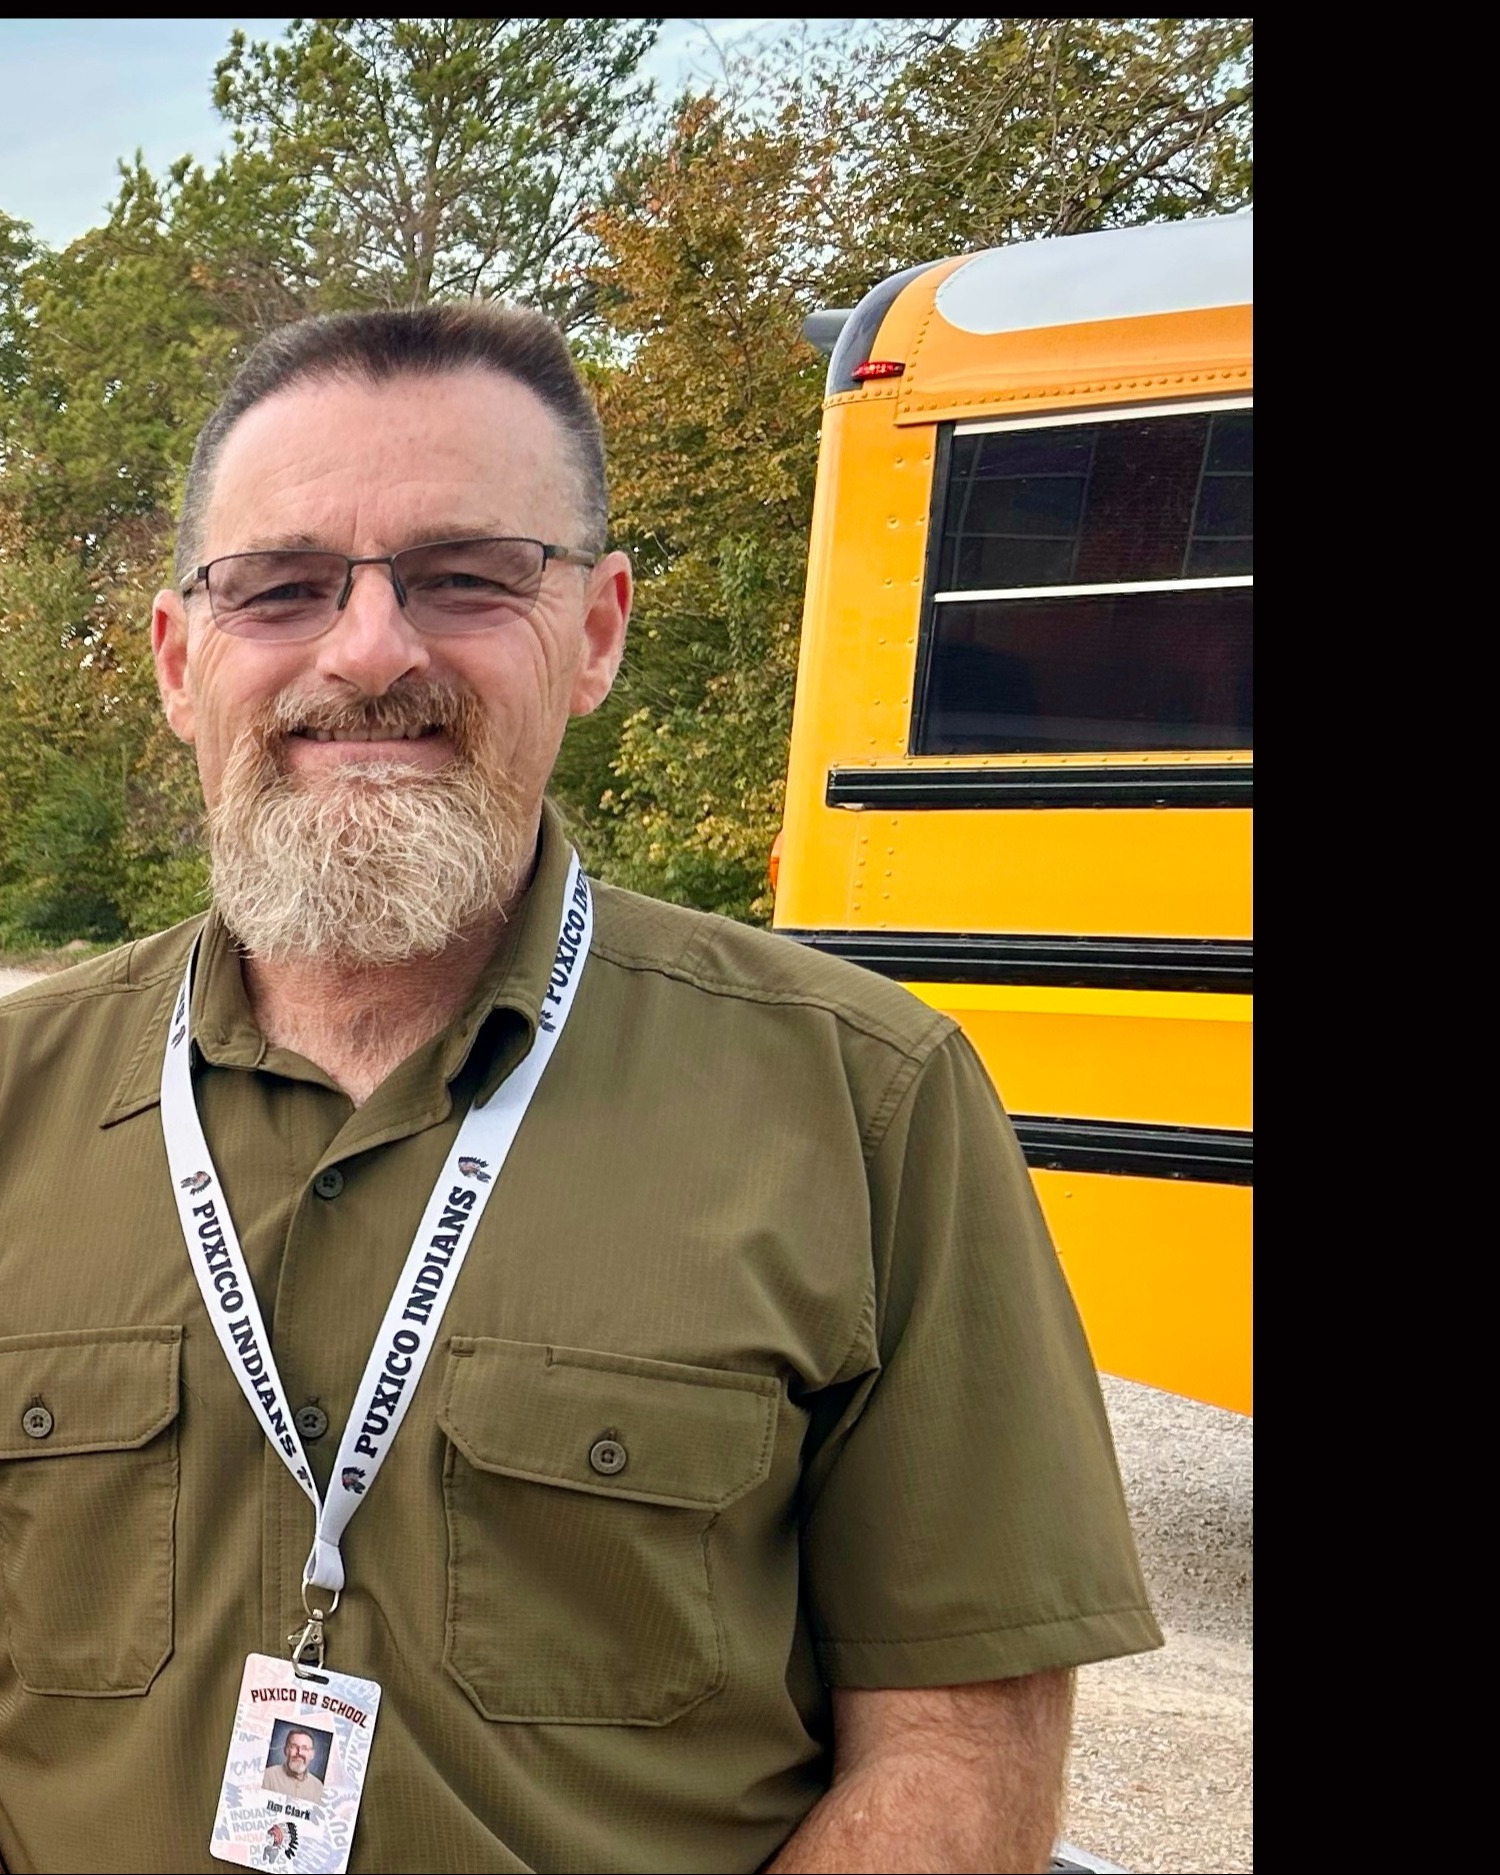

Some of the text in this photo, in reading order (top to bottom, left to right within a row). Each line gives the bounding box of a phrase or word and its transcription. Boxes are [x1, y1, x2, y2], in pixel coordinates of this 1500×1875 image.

[546, 908, 586, 1006] PUXICO
[192, 1199, 297, 1458] PUXICO INDIANS
[354, 1185, 478, 1459] PUXICO INDIANS
[250, 1687, 297, 1703] PUXICO
[321, 1696, 369, 1729] SCHOOL
[284, 1804, 311, 1820] Clark
